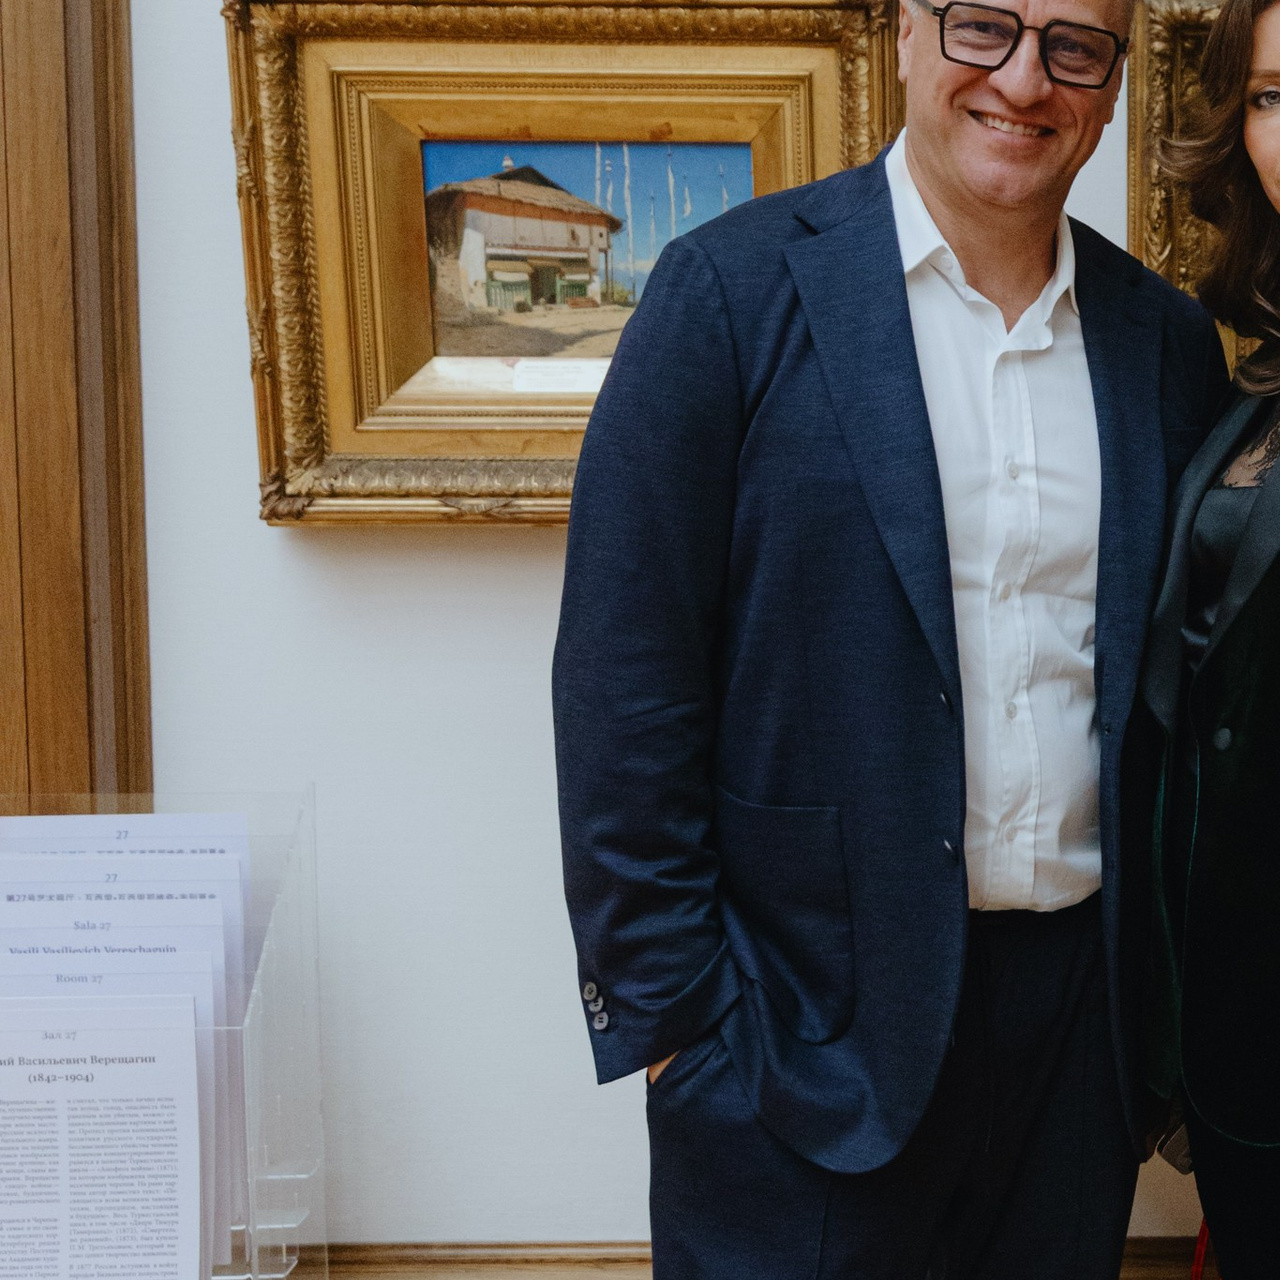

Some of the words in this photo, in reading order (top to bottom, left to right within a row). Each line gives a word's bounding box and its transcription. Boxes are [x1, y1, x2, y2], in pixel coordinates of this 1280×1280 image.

[116, 830, 129, 840] 27
[105, 873, 118, 883] 27
[73, 920, 97, 930] Sala
[99, 922, 112, 932] 27
[56, 974, 89, 983] Room
[91, 975, 104, 985] 27
[41, 1031, 62, 1041] Зал
[65, 1031, 77, 1042] 27
[18, 1056, 88, 1066] Васильевич
[90, 1055, 156, 1066] Верещагин
